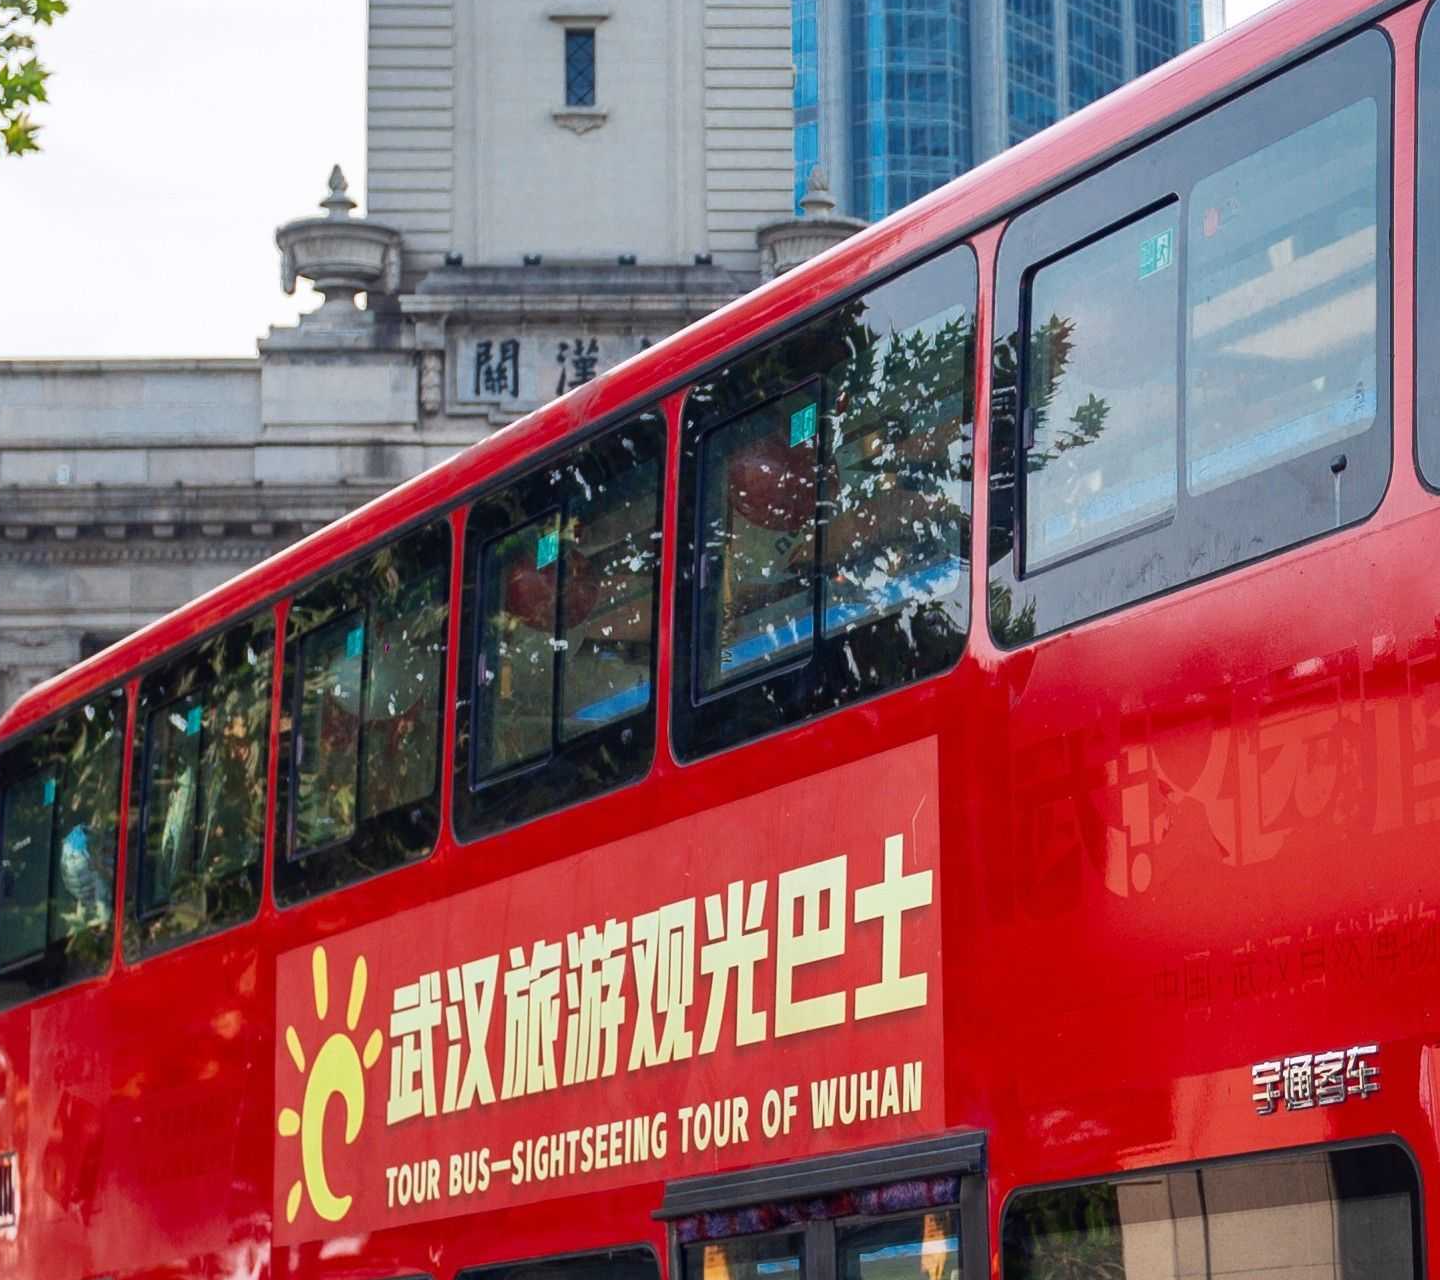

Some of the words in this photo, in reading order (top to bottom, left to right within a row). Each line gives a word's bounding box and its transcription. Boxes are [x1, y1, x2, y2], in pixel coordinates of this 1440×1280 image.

[386, 833, 934, 1125] 武汉旅游观光巴士
[385, 1159, 441, 1208] TOUR
[678, 1096, 750, 1154] TOUR
[761, 1085, 799, 1139] OF
[811, 1061, 923, 1130] WUHAN
[1252, 1044, 1379, 1116] 宇通客车
